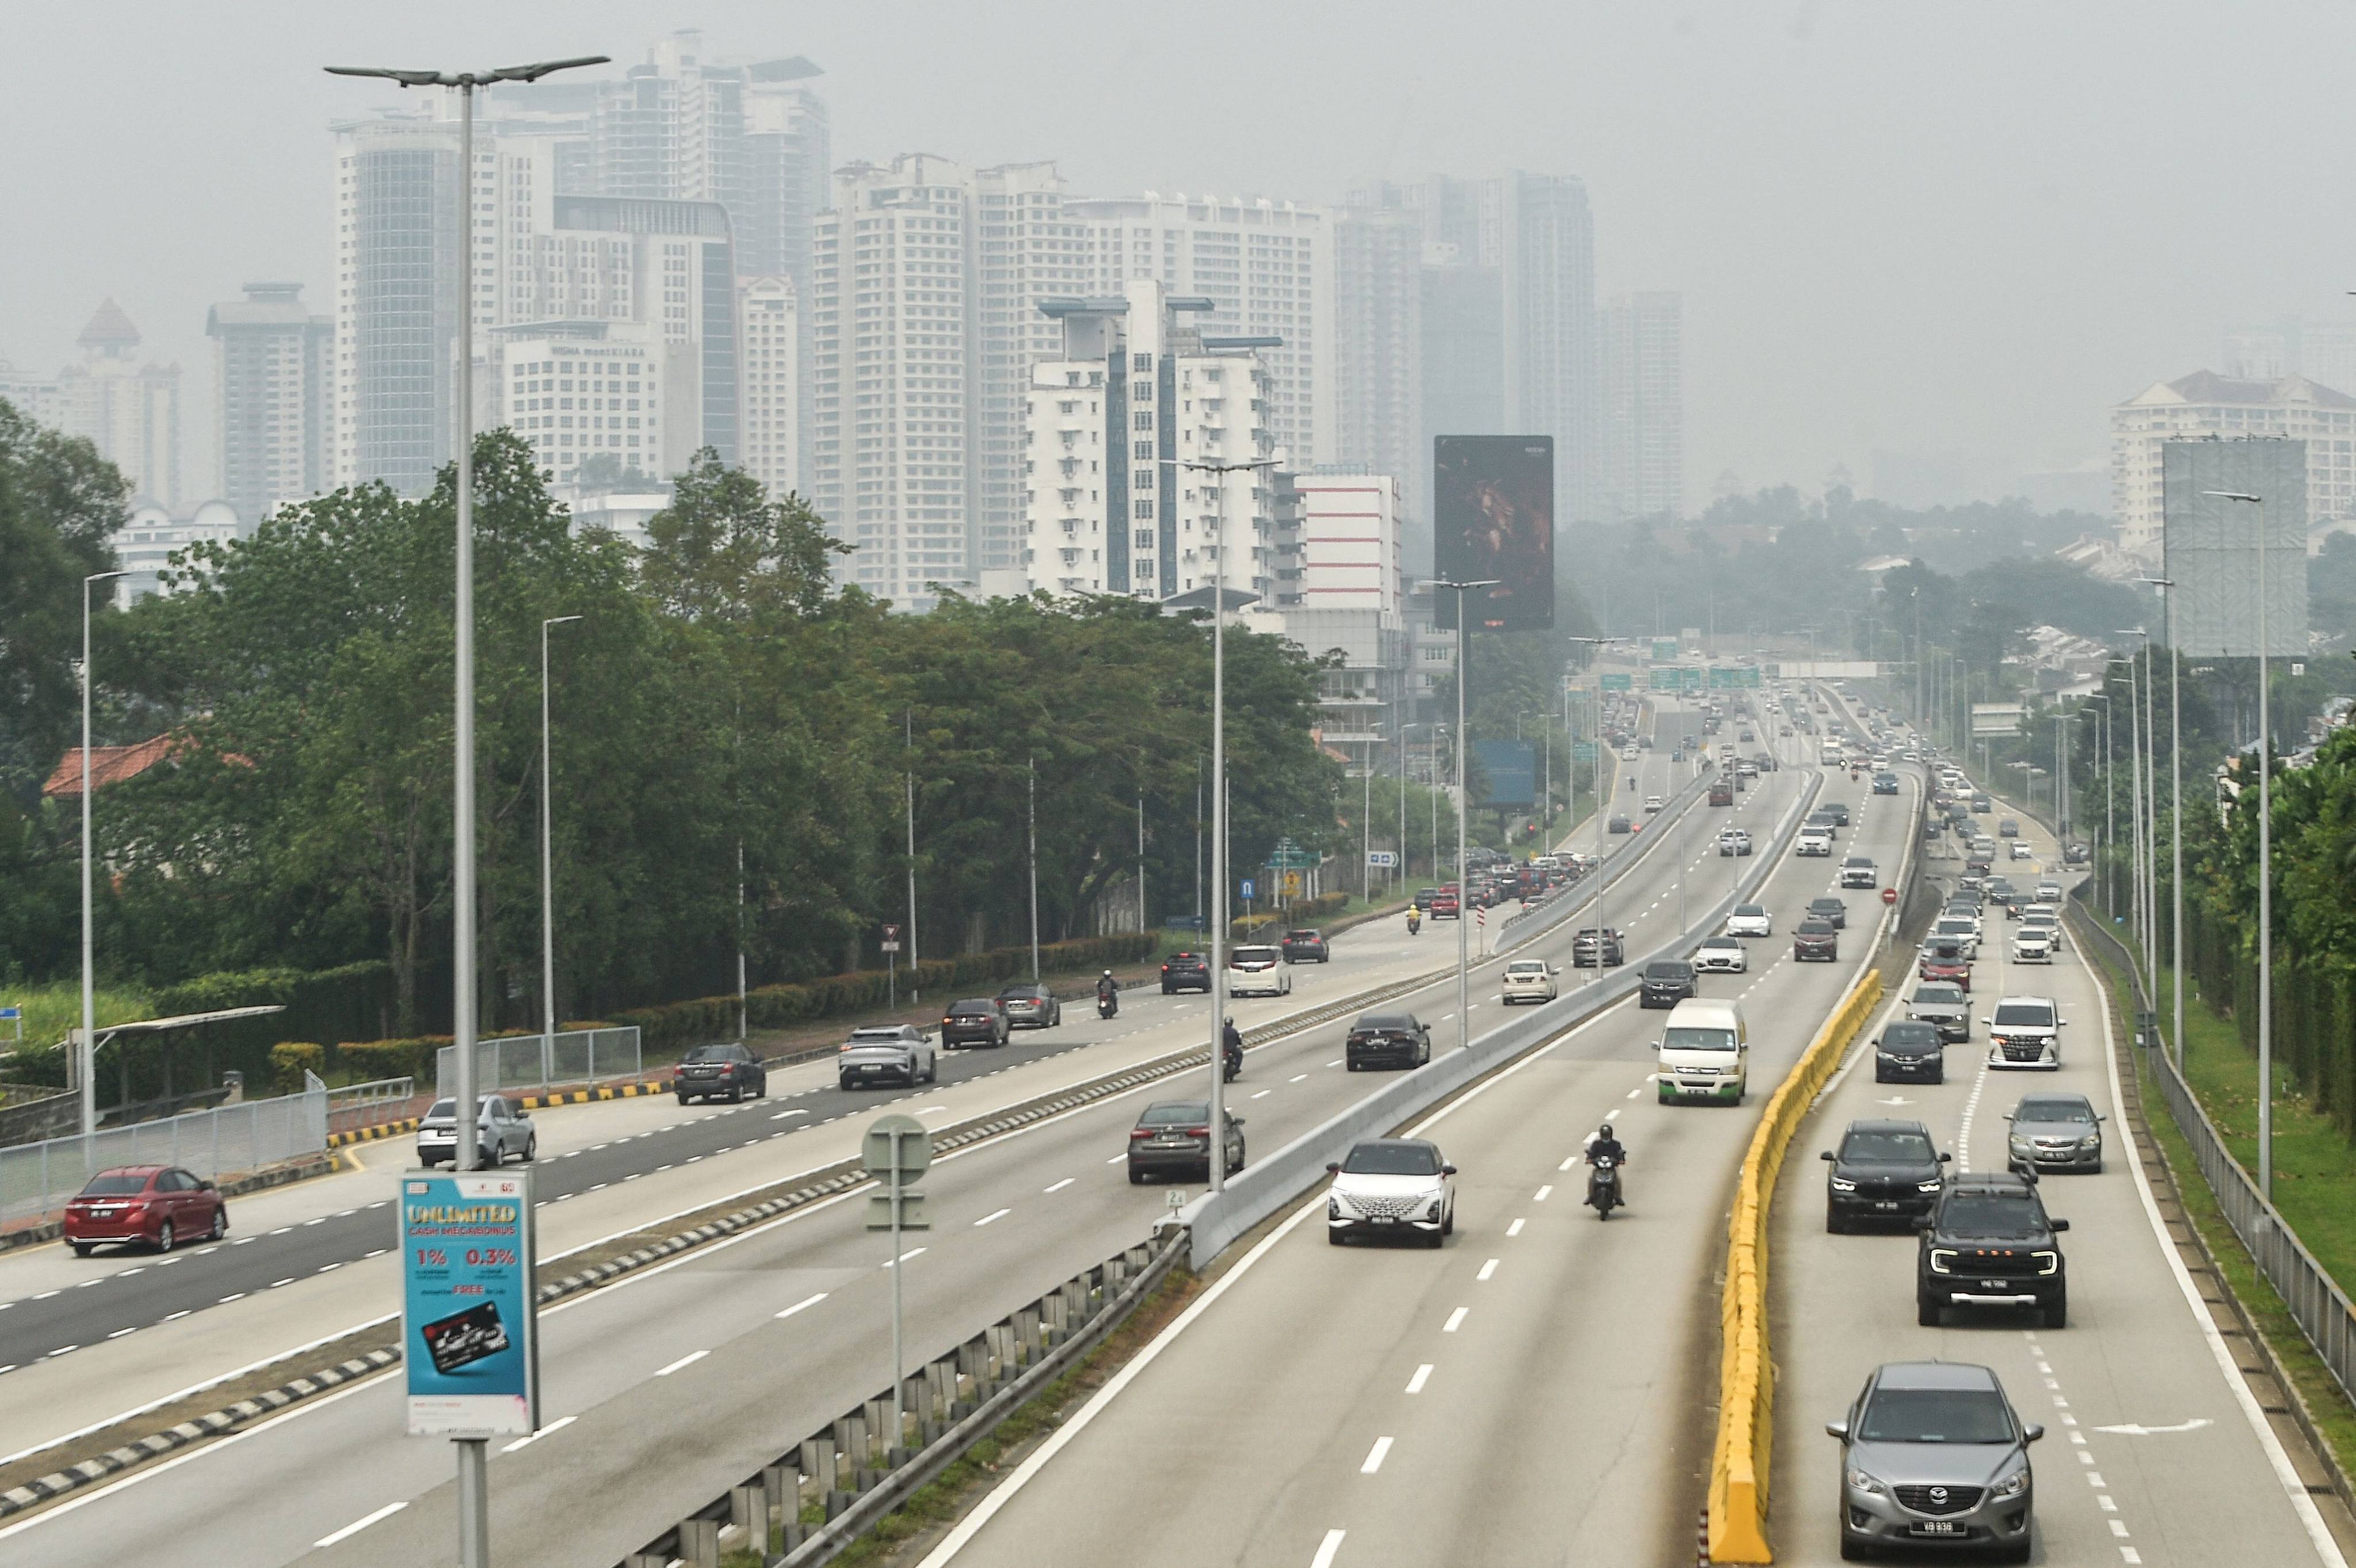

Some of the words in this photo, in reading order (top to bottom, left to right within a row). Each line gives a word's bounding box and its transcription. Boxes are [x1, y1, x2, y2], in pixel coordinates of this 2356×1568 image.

[551, 346, 581, 355] WISMA
[584, 348, 646, 357] montKIARA
[408, 1205, 516, 1223] UNLIMITED
[408, 1226, 440, 1236] CASH
[441, 1226, 516, 1236] MEGABONUS
[417, 1248, 448, 1265] 1%
[465, 1248, 517, 1265] 0.3%
[452, 1284, 484, 1295] FREE
